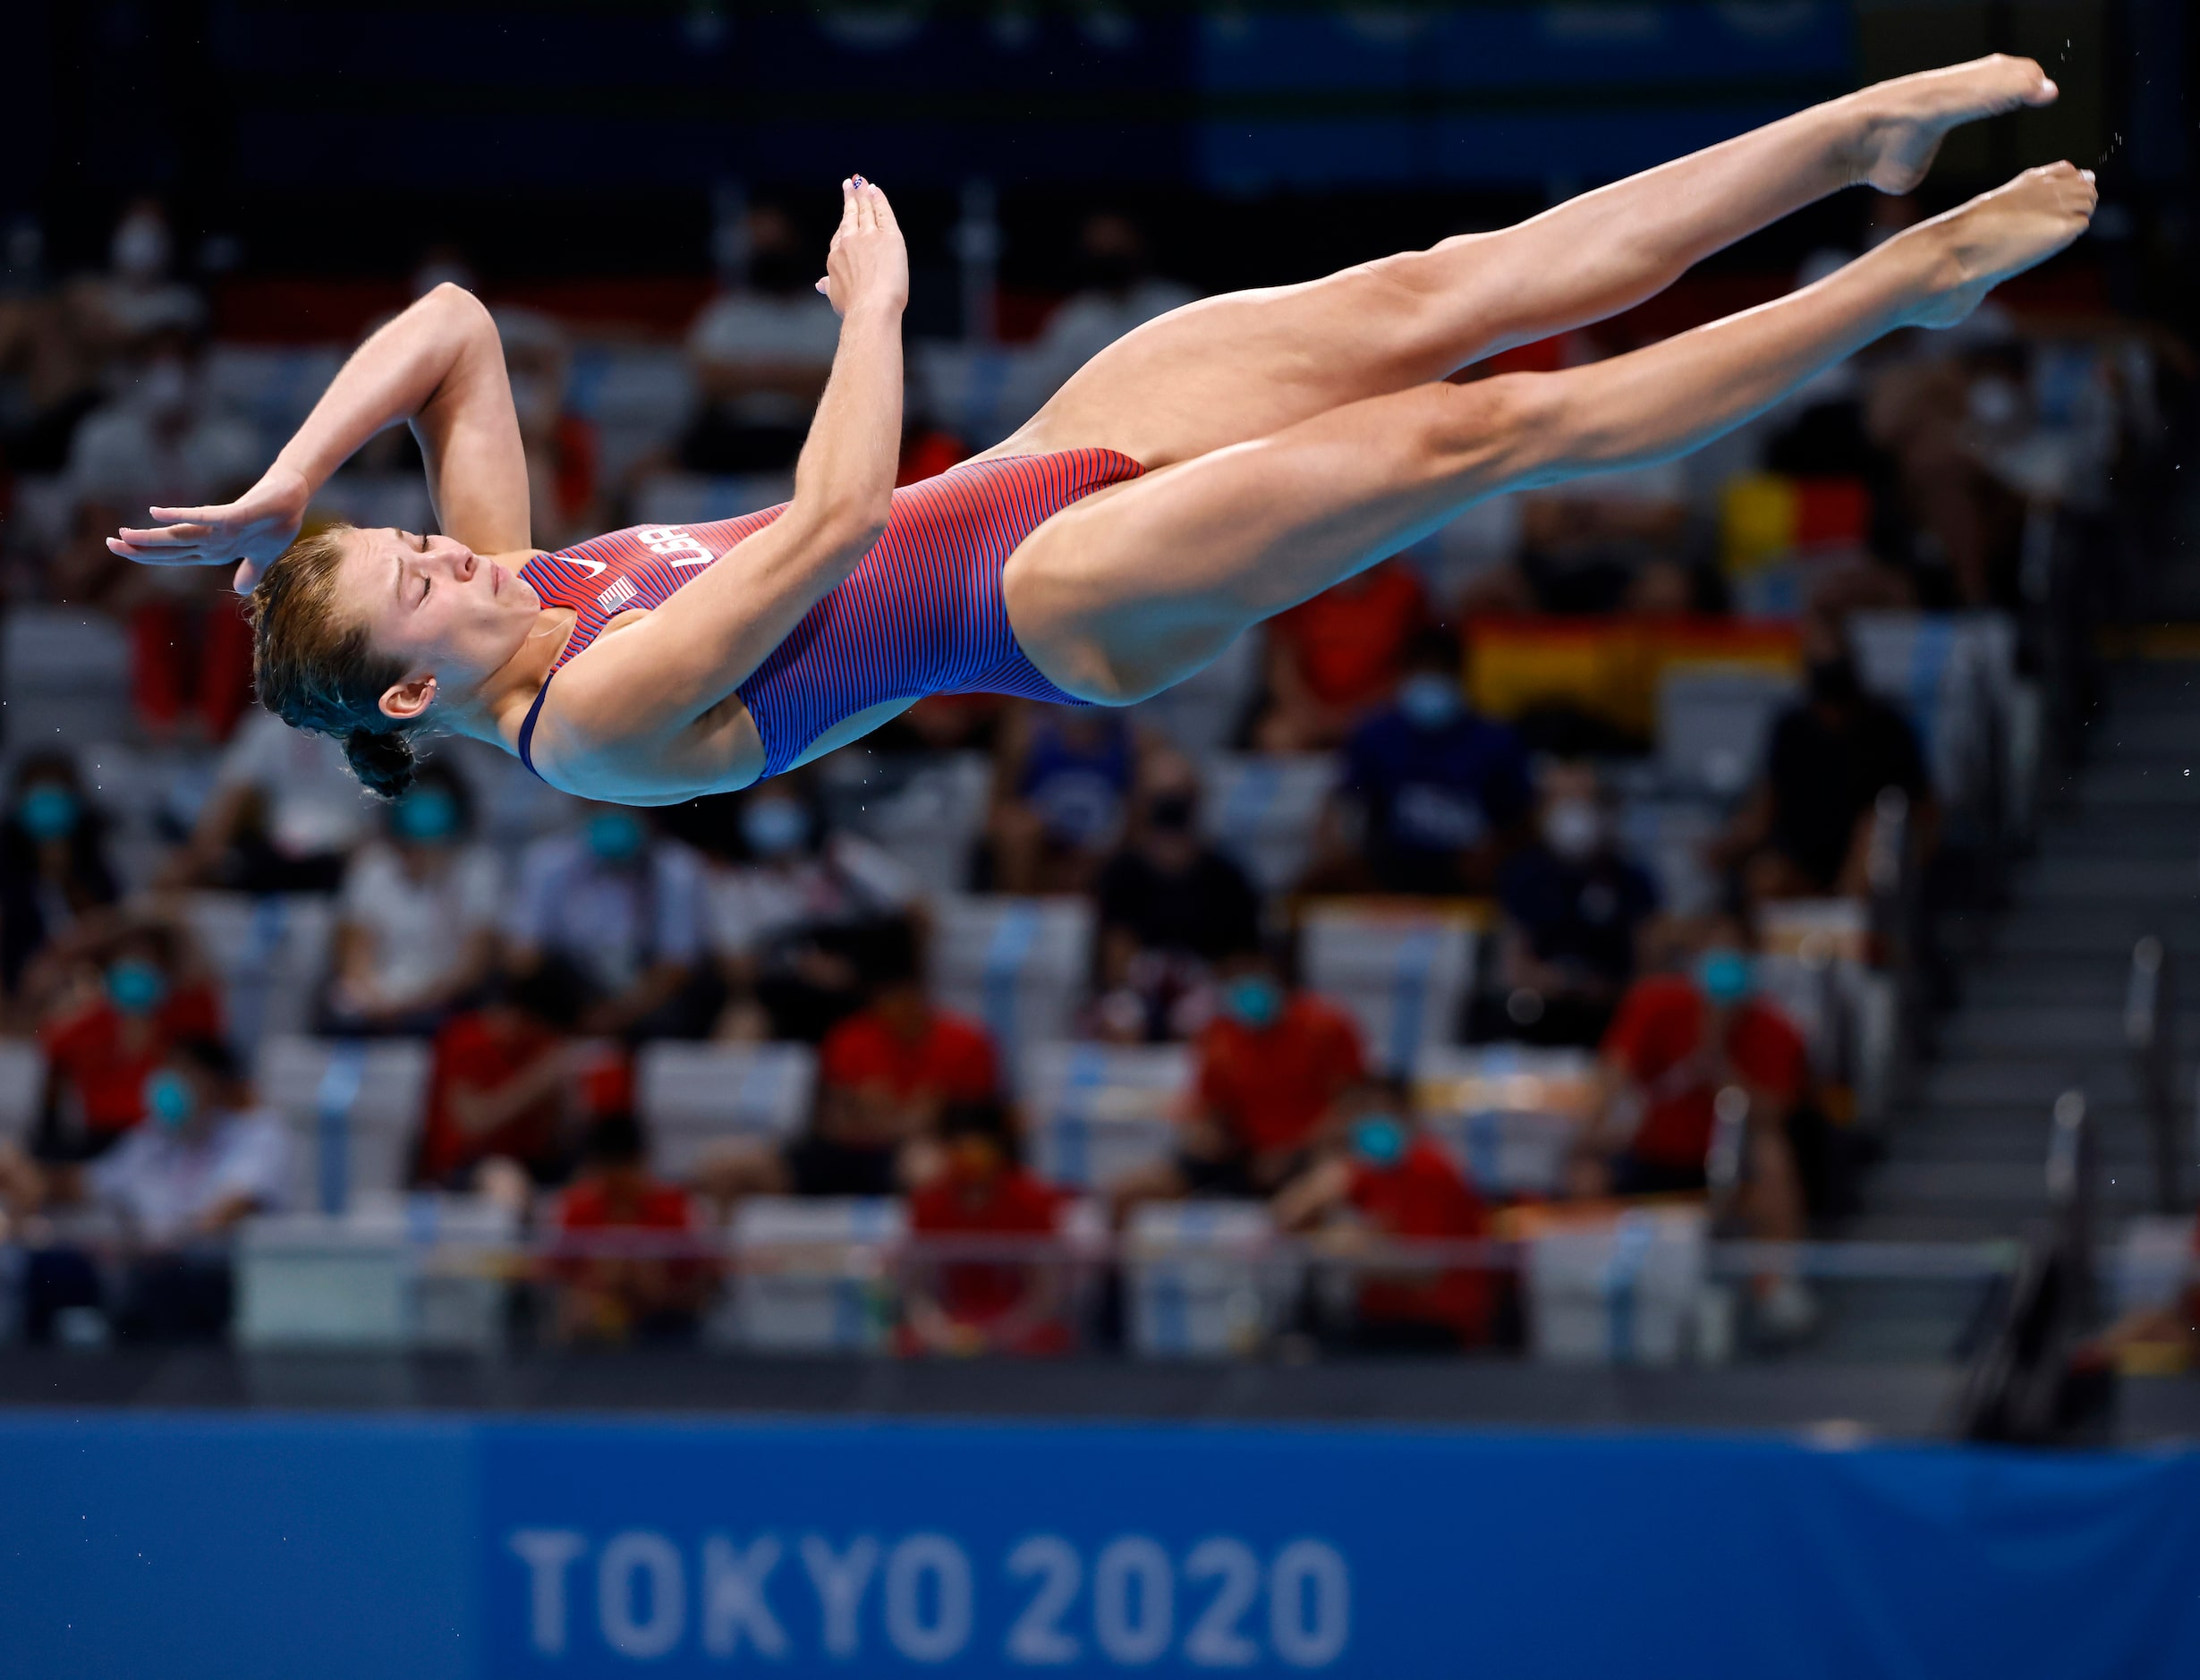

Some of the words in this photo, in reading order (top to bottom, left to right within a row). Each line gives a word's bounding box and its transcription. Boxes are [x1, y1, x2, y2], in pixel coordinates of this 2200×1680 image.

[637, 526, 714, 568] USA
[510, 1530, 973, 1659] TOKYO
[1005, 1535, 1349, 1667] 2020
